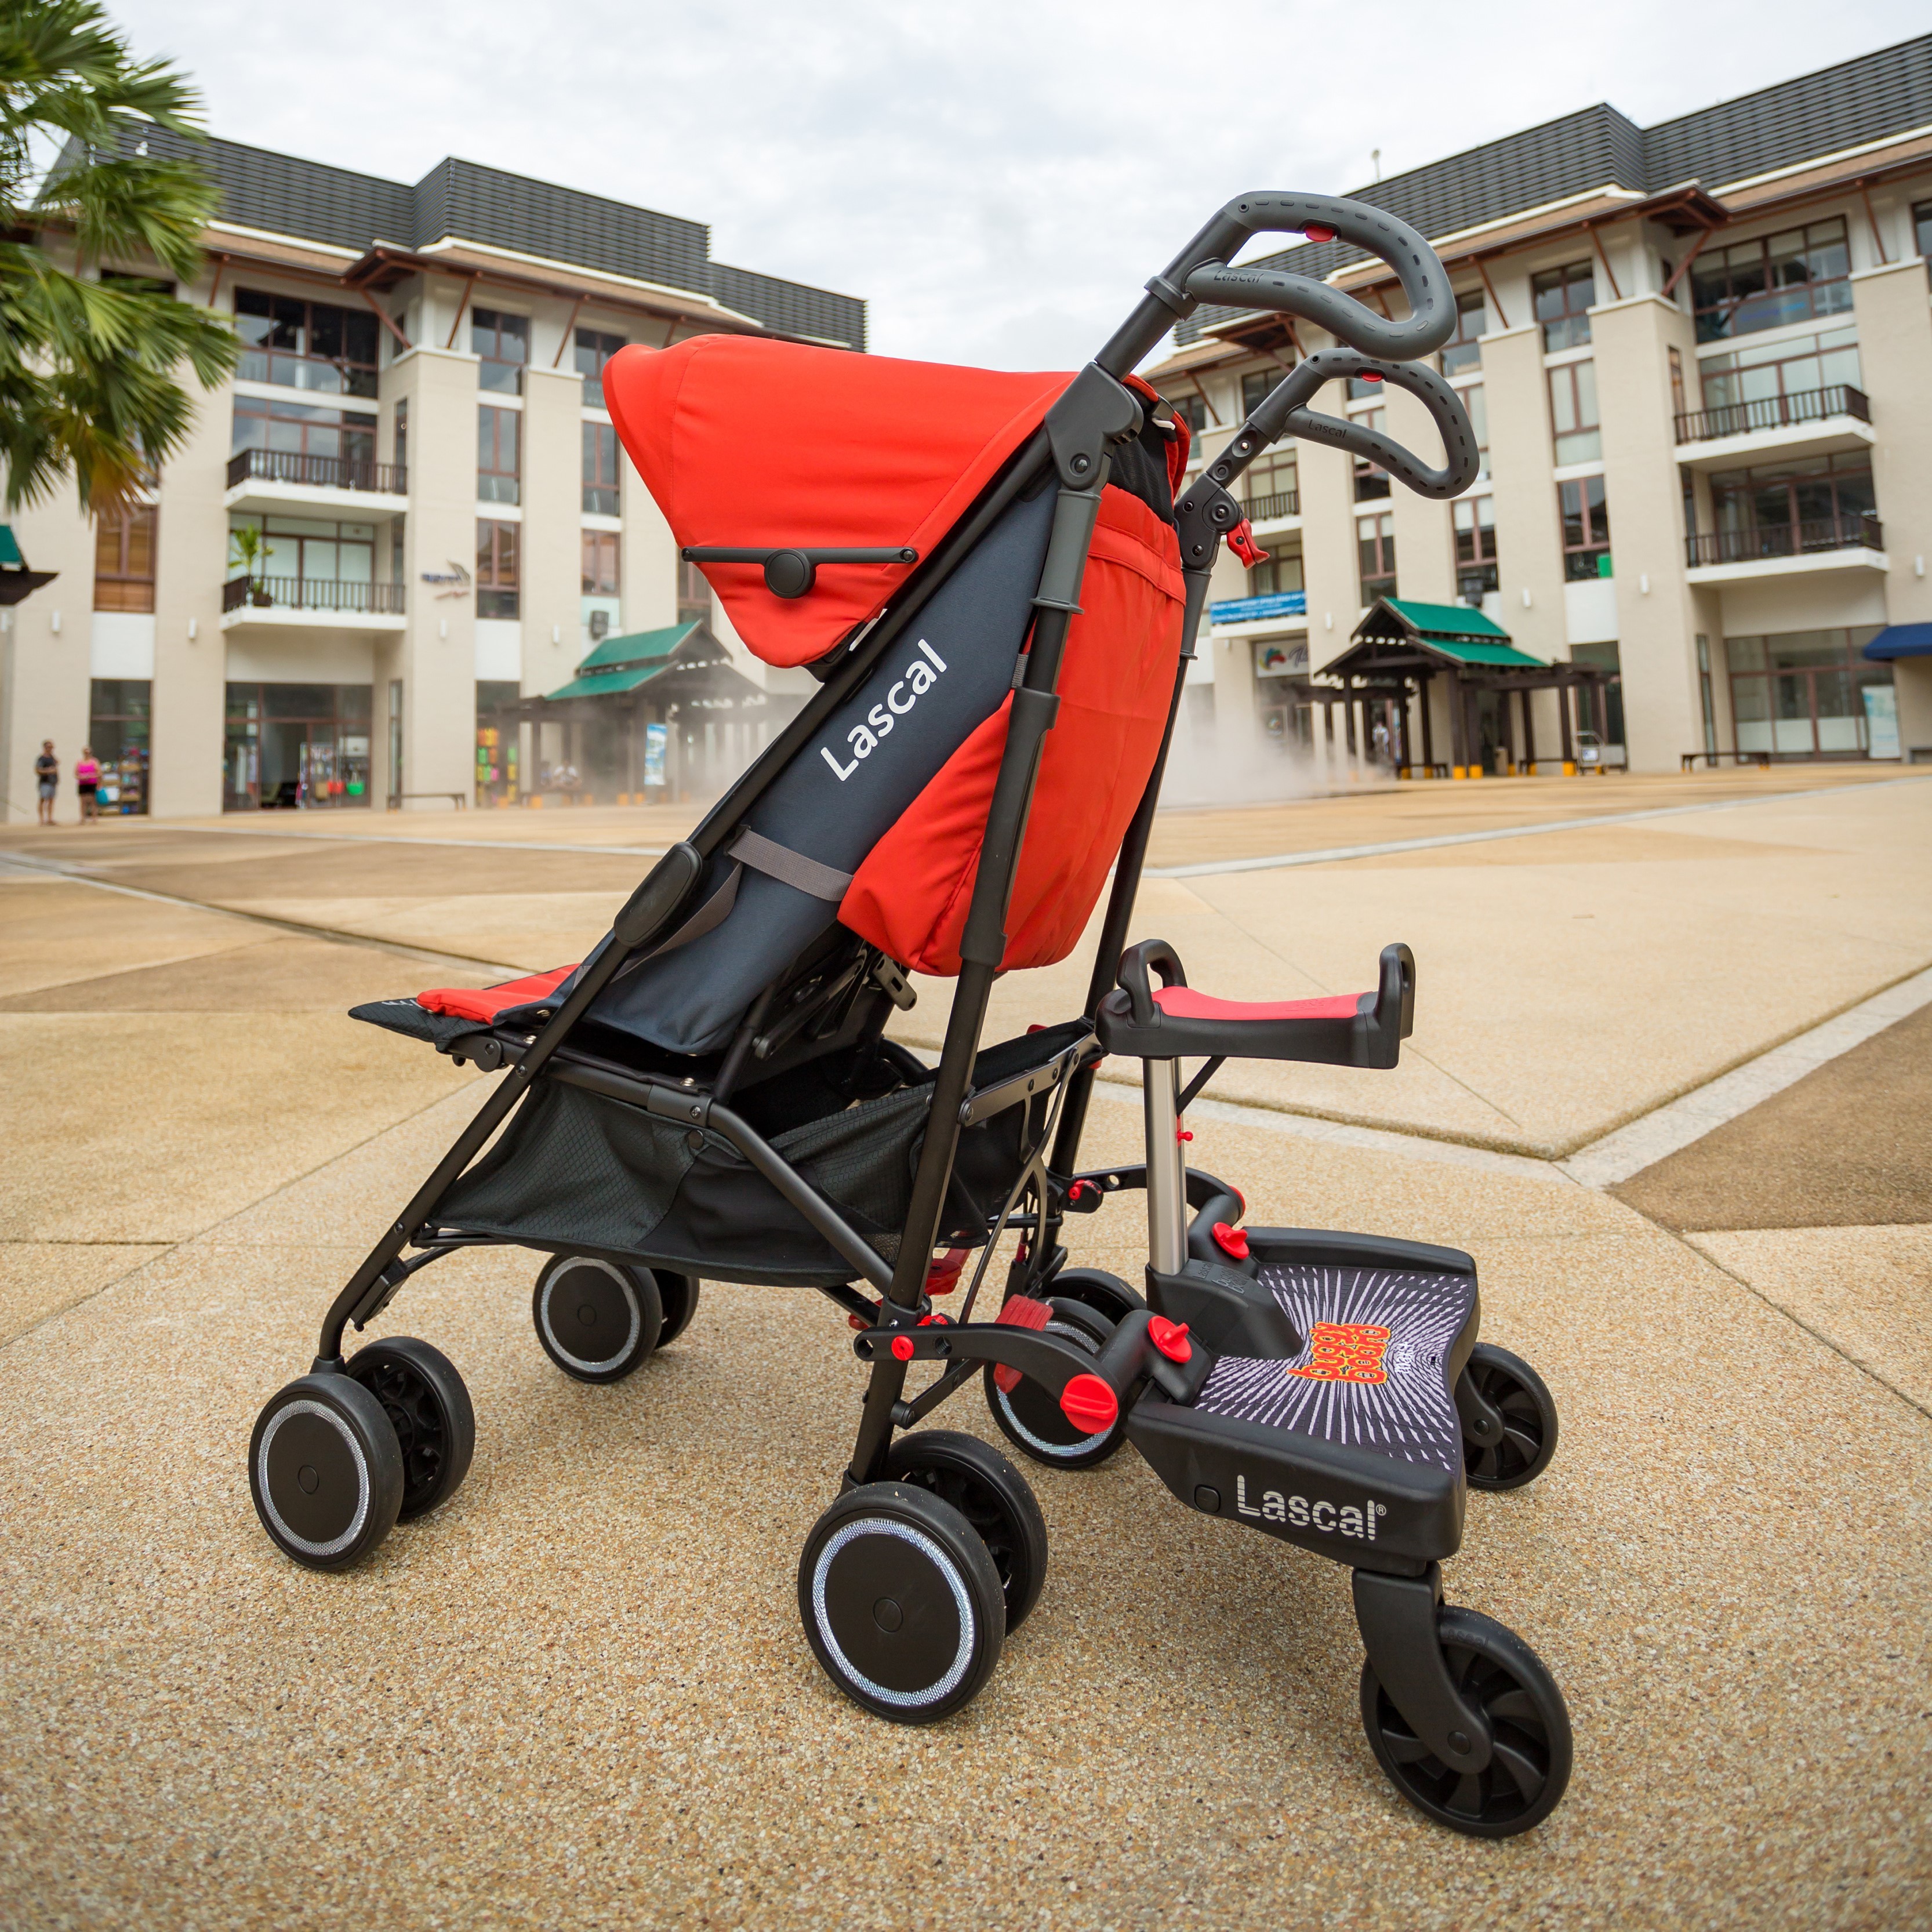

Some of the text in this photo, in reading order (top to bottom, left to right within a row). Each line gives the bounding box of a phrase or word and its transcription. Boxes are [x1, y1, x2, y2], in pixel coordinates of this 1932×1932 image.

[1214, 270, 1264, 284] Lascal
[1308, 419, 1348, 439] Lascal
[820, 639, 947, 781] Lascal
[1286, 1321, 1356, 1381] buggy
[1338, 1324, 1391, 1384] board
